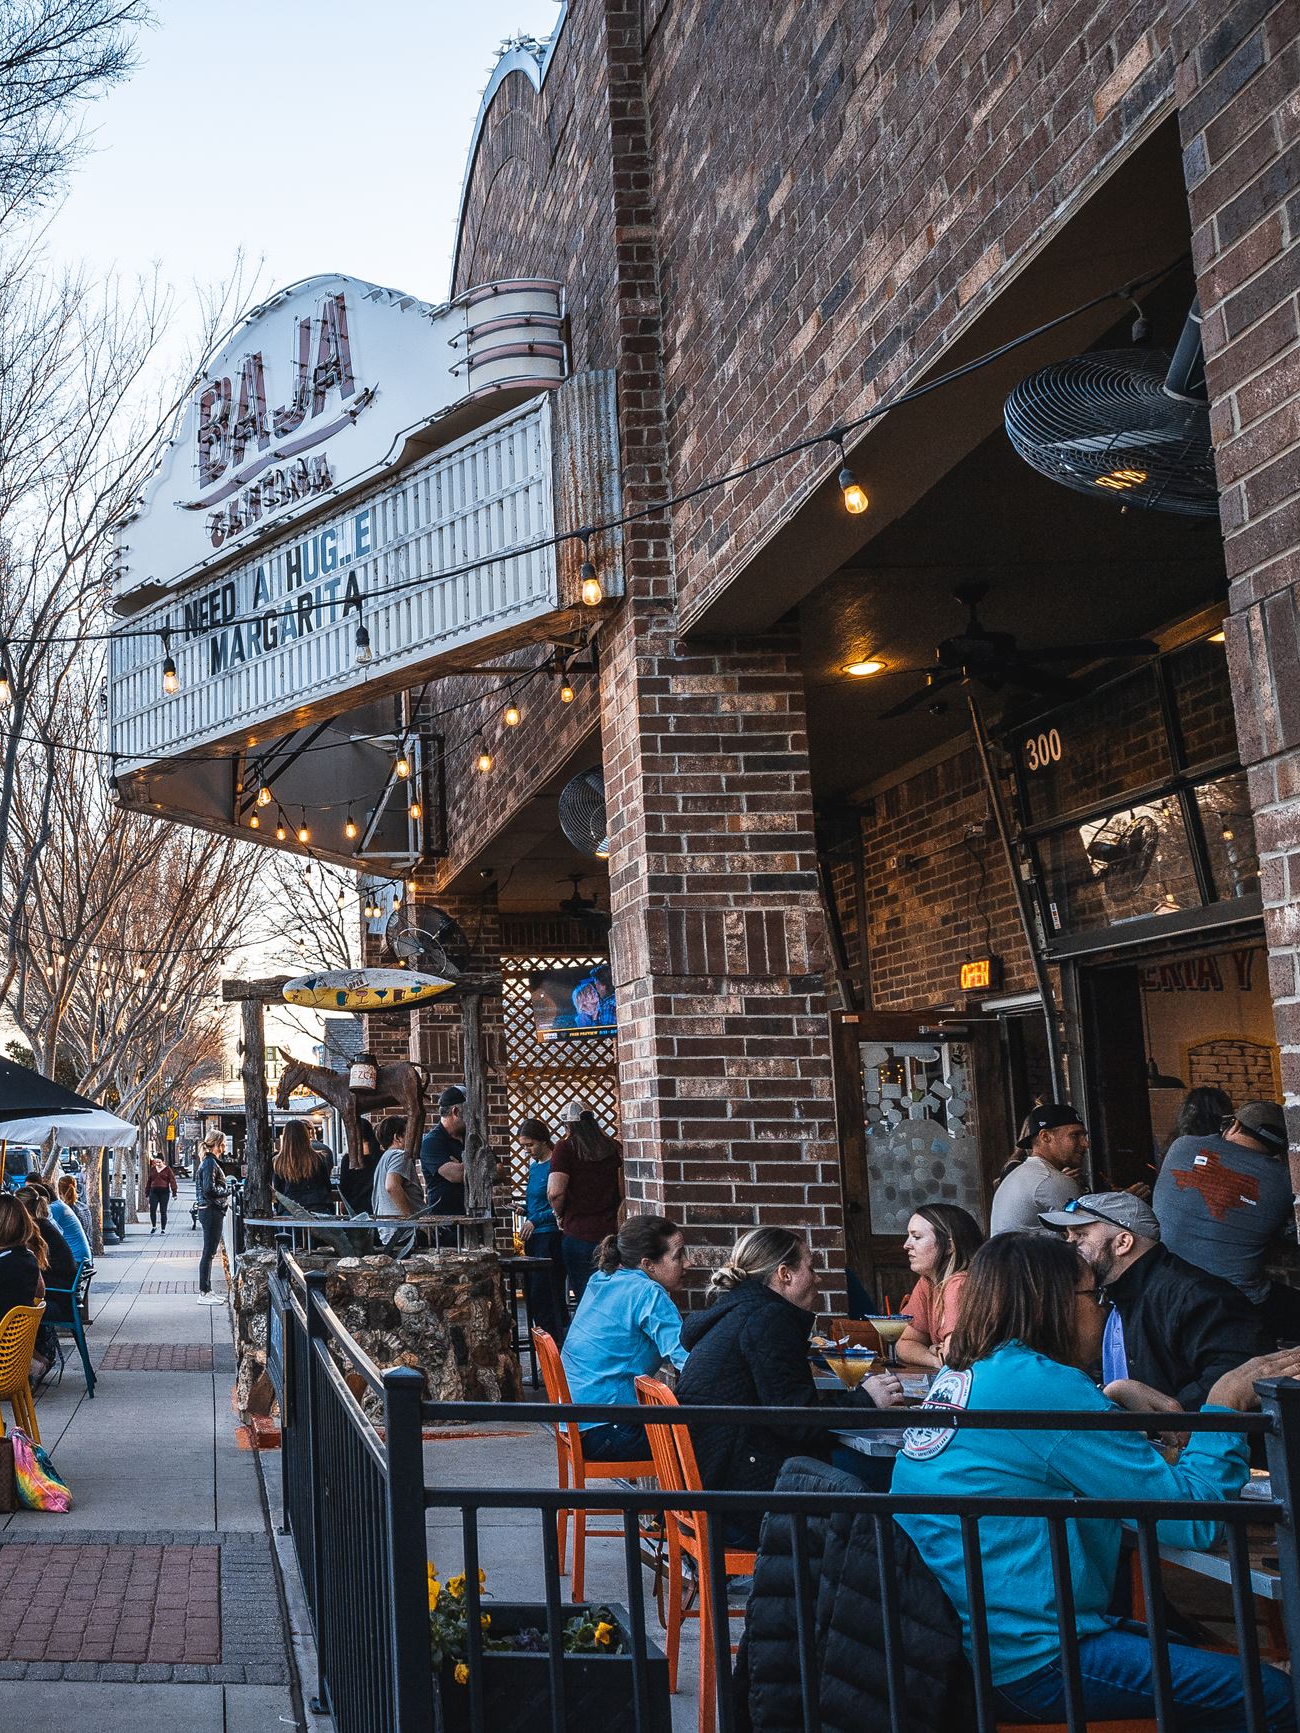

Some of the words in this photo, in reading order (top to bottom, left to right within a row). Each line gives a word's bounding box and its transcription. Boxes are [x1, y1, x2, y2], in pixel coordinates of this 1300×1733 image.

[194, 290, 356, 489] BAJA
[185, 582, 236, 642] NEED
[253, 565, 270, 609] A
[210, 570, 360, 676] MARGARITA
[1025, 728, 1062, 770] 300
[960, 959, 990, 989] OPEN
